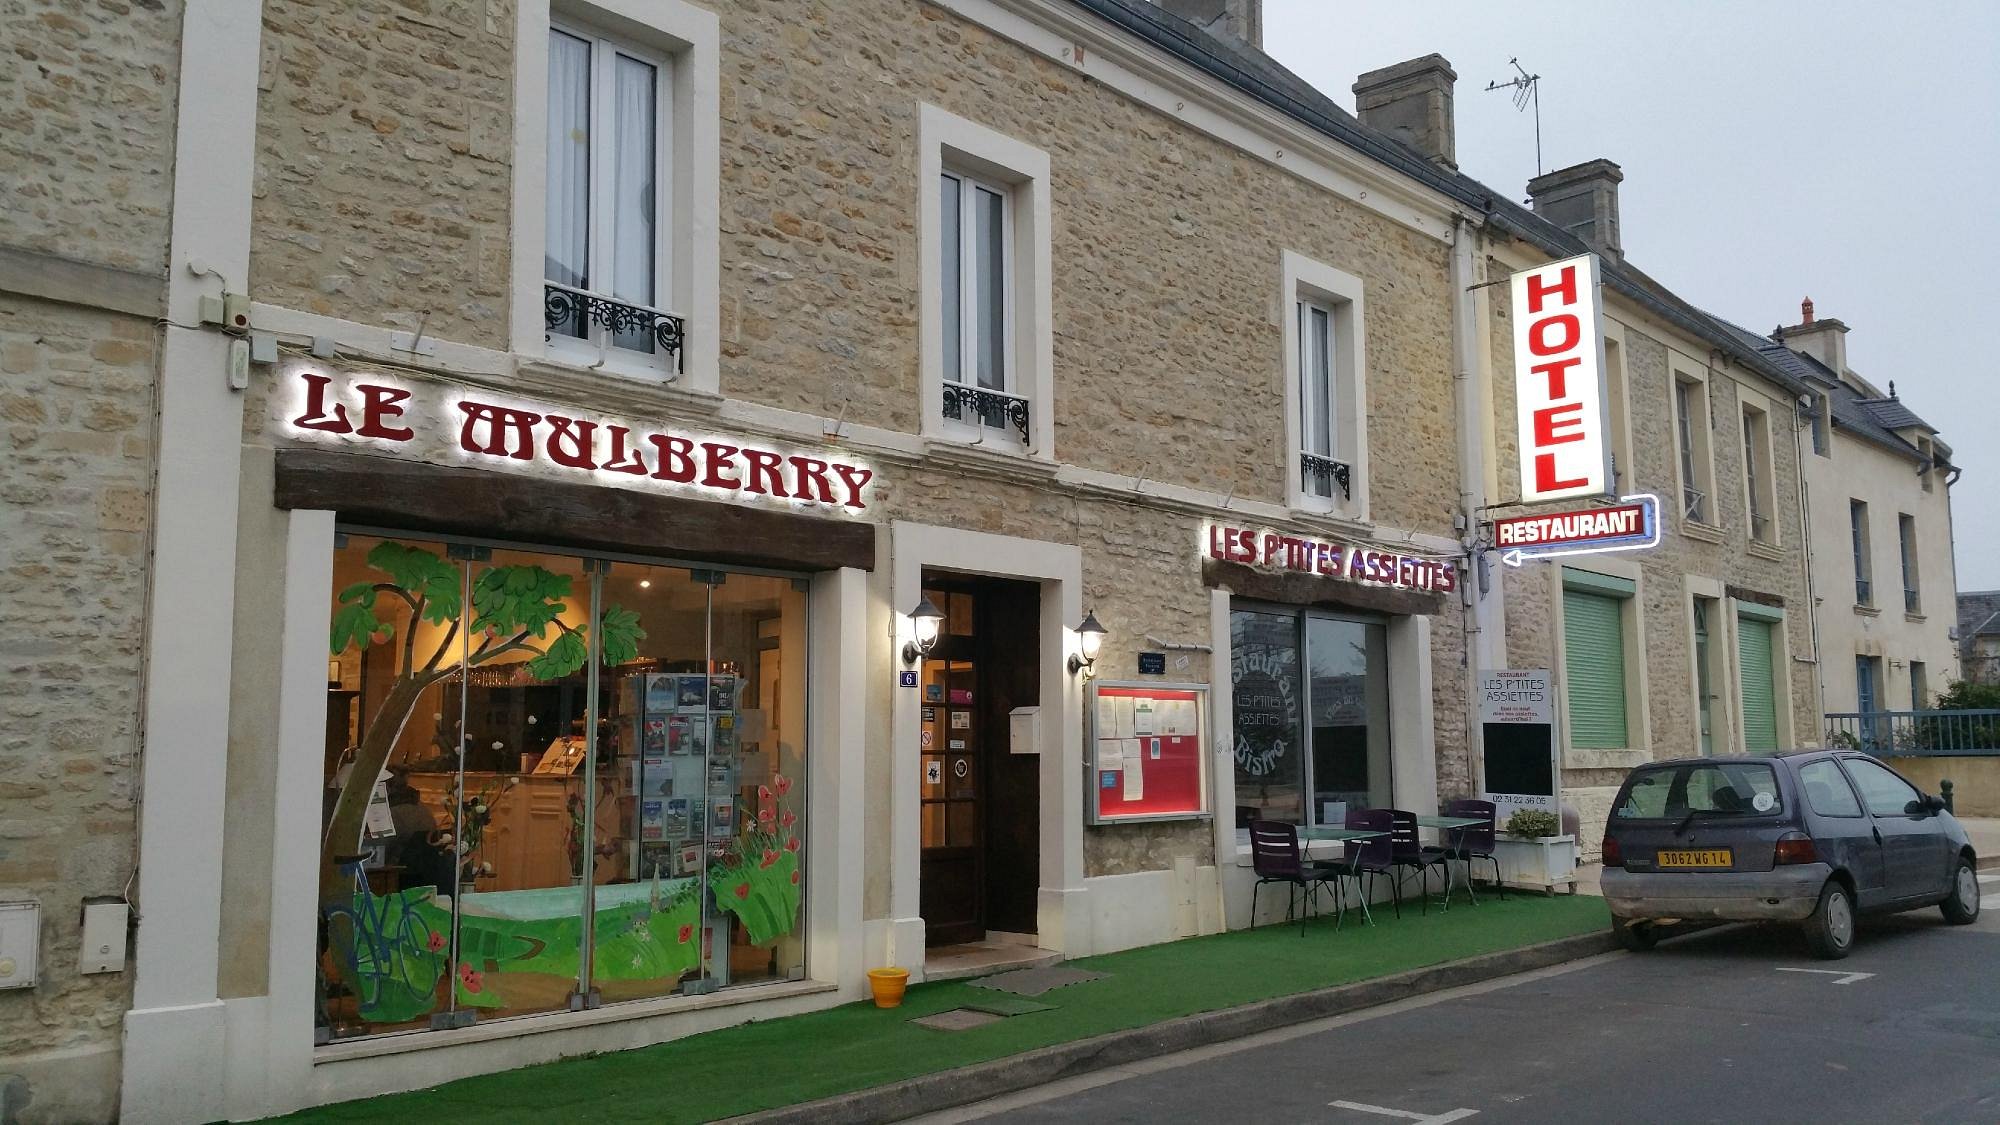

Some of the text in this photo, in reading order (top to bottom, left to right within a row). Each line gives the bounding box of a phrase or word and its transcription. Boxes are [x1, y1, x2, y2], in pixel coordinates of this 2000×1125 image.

[1526, 265, 1589, 494] HOTEL
[293, 373, 873, 509] LE MULBERRY
[1499, 509, 1640, 545] RESTAURANT
[1210, 524, 1456, 593] LES P'TITES ASSIETTES
[905, 673, 912, 685] 6
[1484, 679, 1545, 690] LES P'TITES
[1486, 691, 1544, 702] ASSIETTES
